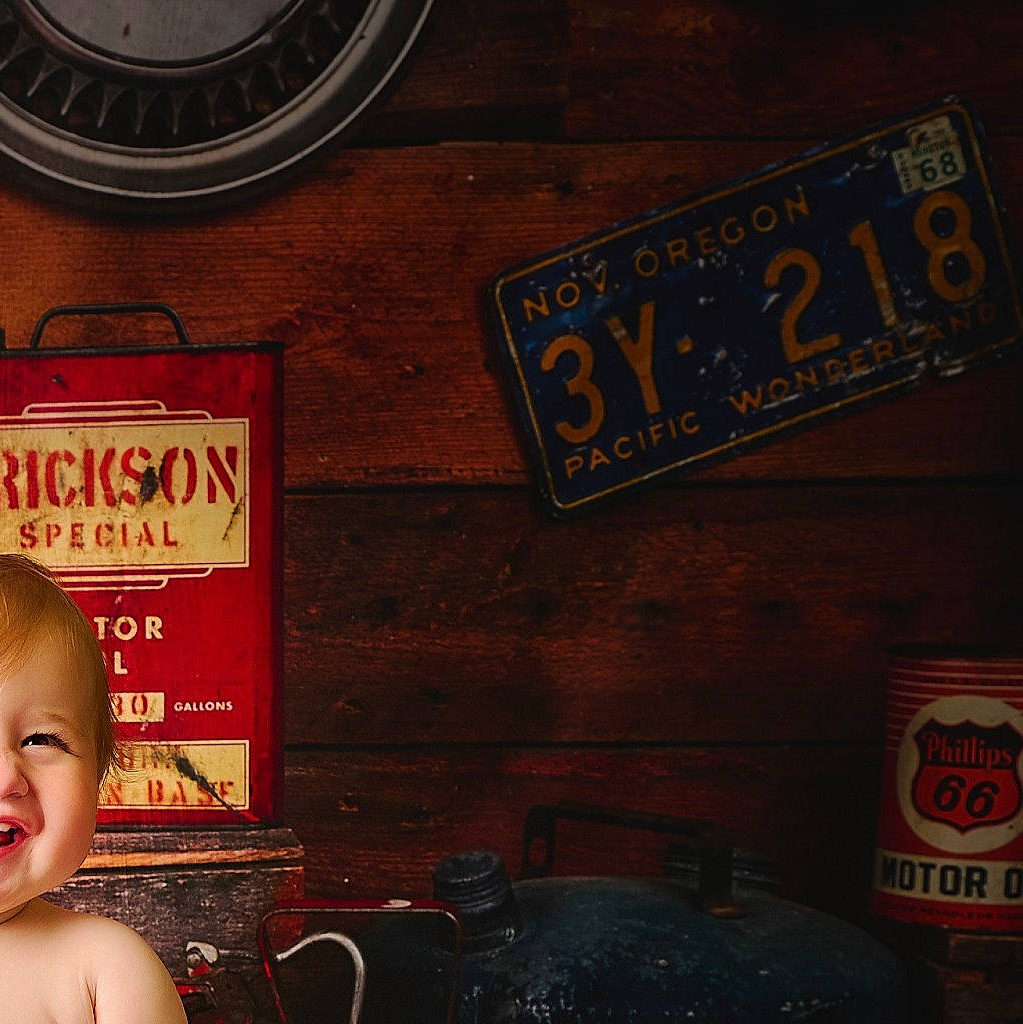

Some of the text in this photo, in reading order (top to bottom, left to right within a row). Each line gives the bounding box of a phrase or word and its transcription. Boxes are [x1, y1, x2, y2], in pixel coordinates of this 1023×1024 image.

[921, 150, 957, 183] 68
[634, 190, 812, 279] OREGON
[562, 302, 998, 481] PACIFIC WONDERLAND
[19, 520, 179, 550] SPECIAL
[173, 700, 234, 713] GALLONS
[922, 729, 1014, 770] Phillips
[933, 774, 1000, 819] 66
[881, 856, 988, 899] MOTOR
